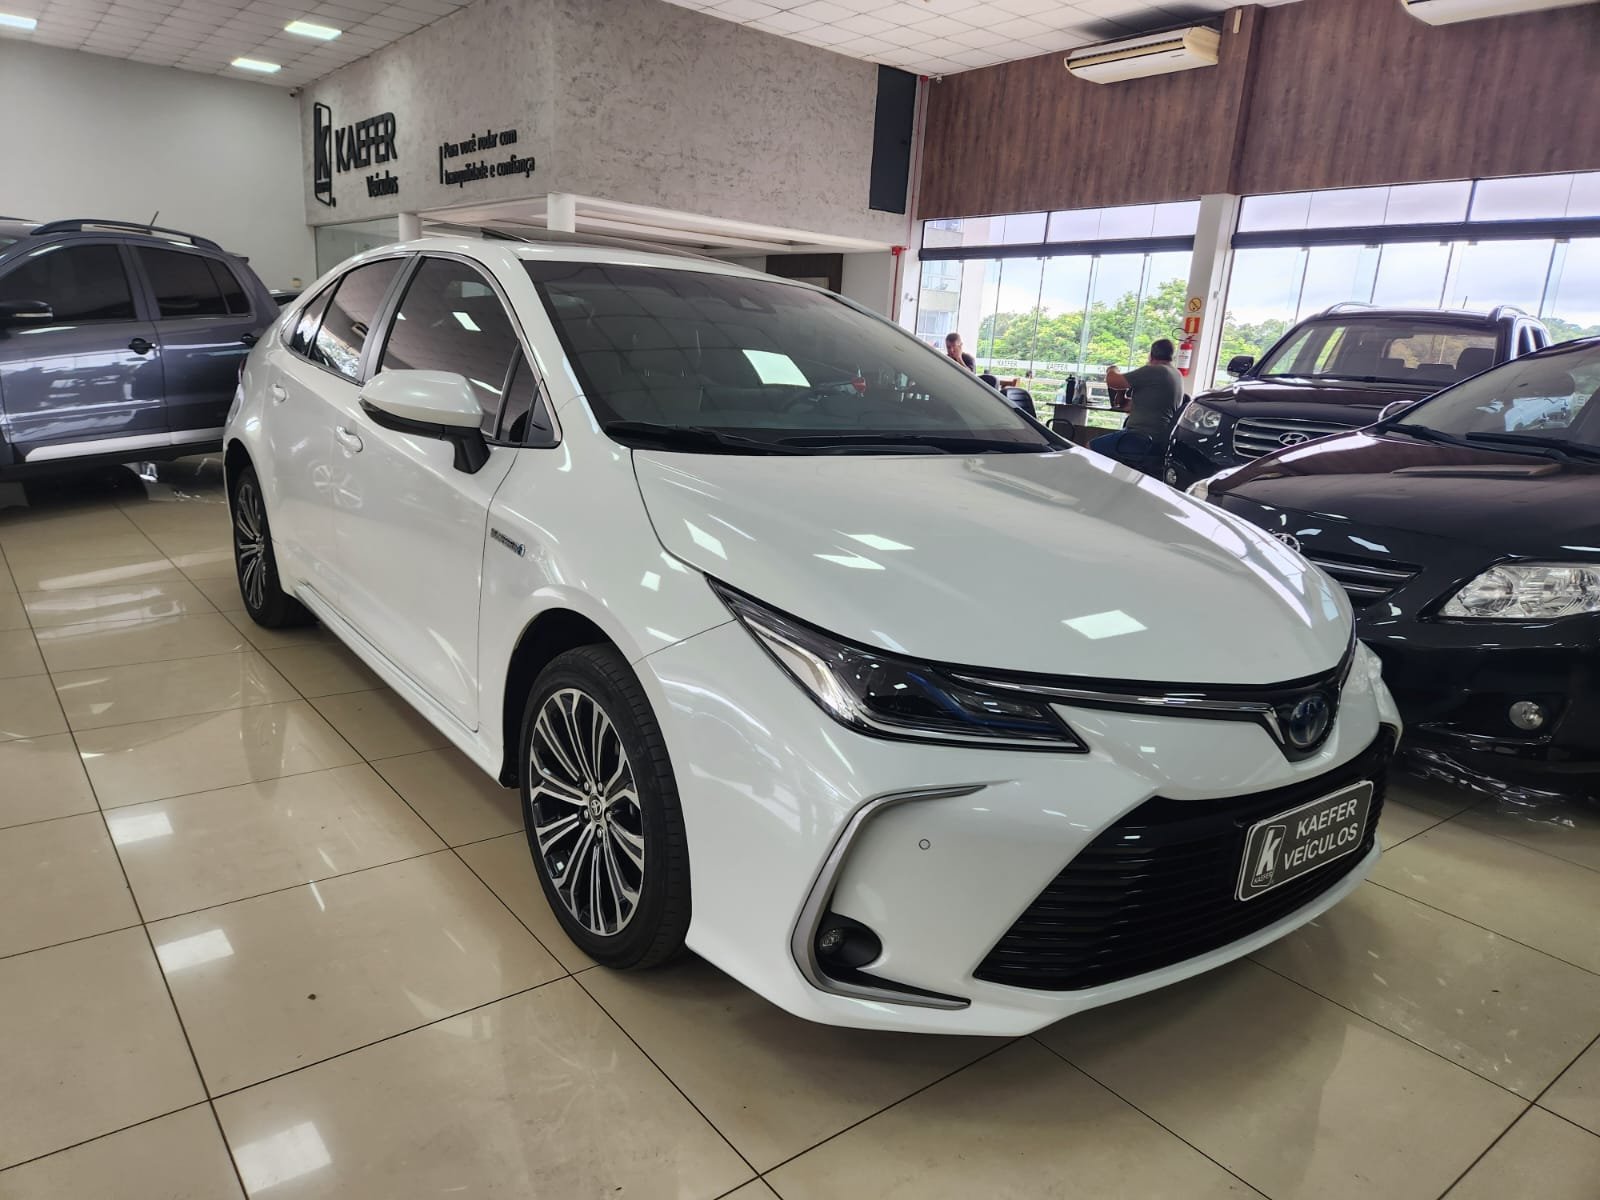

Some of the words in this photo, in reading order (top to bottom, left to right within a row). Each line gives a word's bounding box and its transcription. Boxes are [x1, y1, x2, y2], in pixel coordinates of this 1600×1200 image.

[335, 112, 398, 173] KAEFER
[444, 142, 459, 159] Para
[459, 133, 477, 155] você
[478, 129, 498, 150] rodar
[500, 129, 517, 146] com
[445, 160, 489, 188] tranquilidade
[489, 164, 495, 177] e
[497, 154, 535, 178] confiança
[1296, 799, 1358, 840] KAEFER
[1284, 823, 1359, 870] VEÍCULOS
